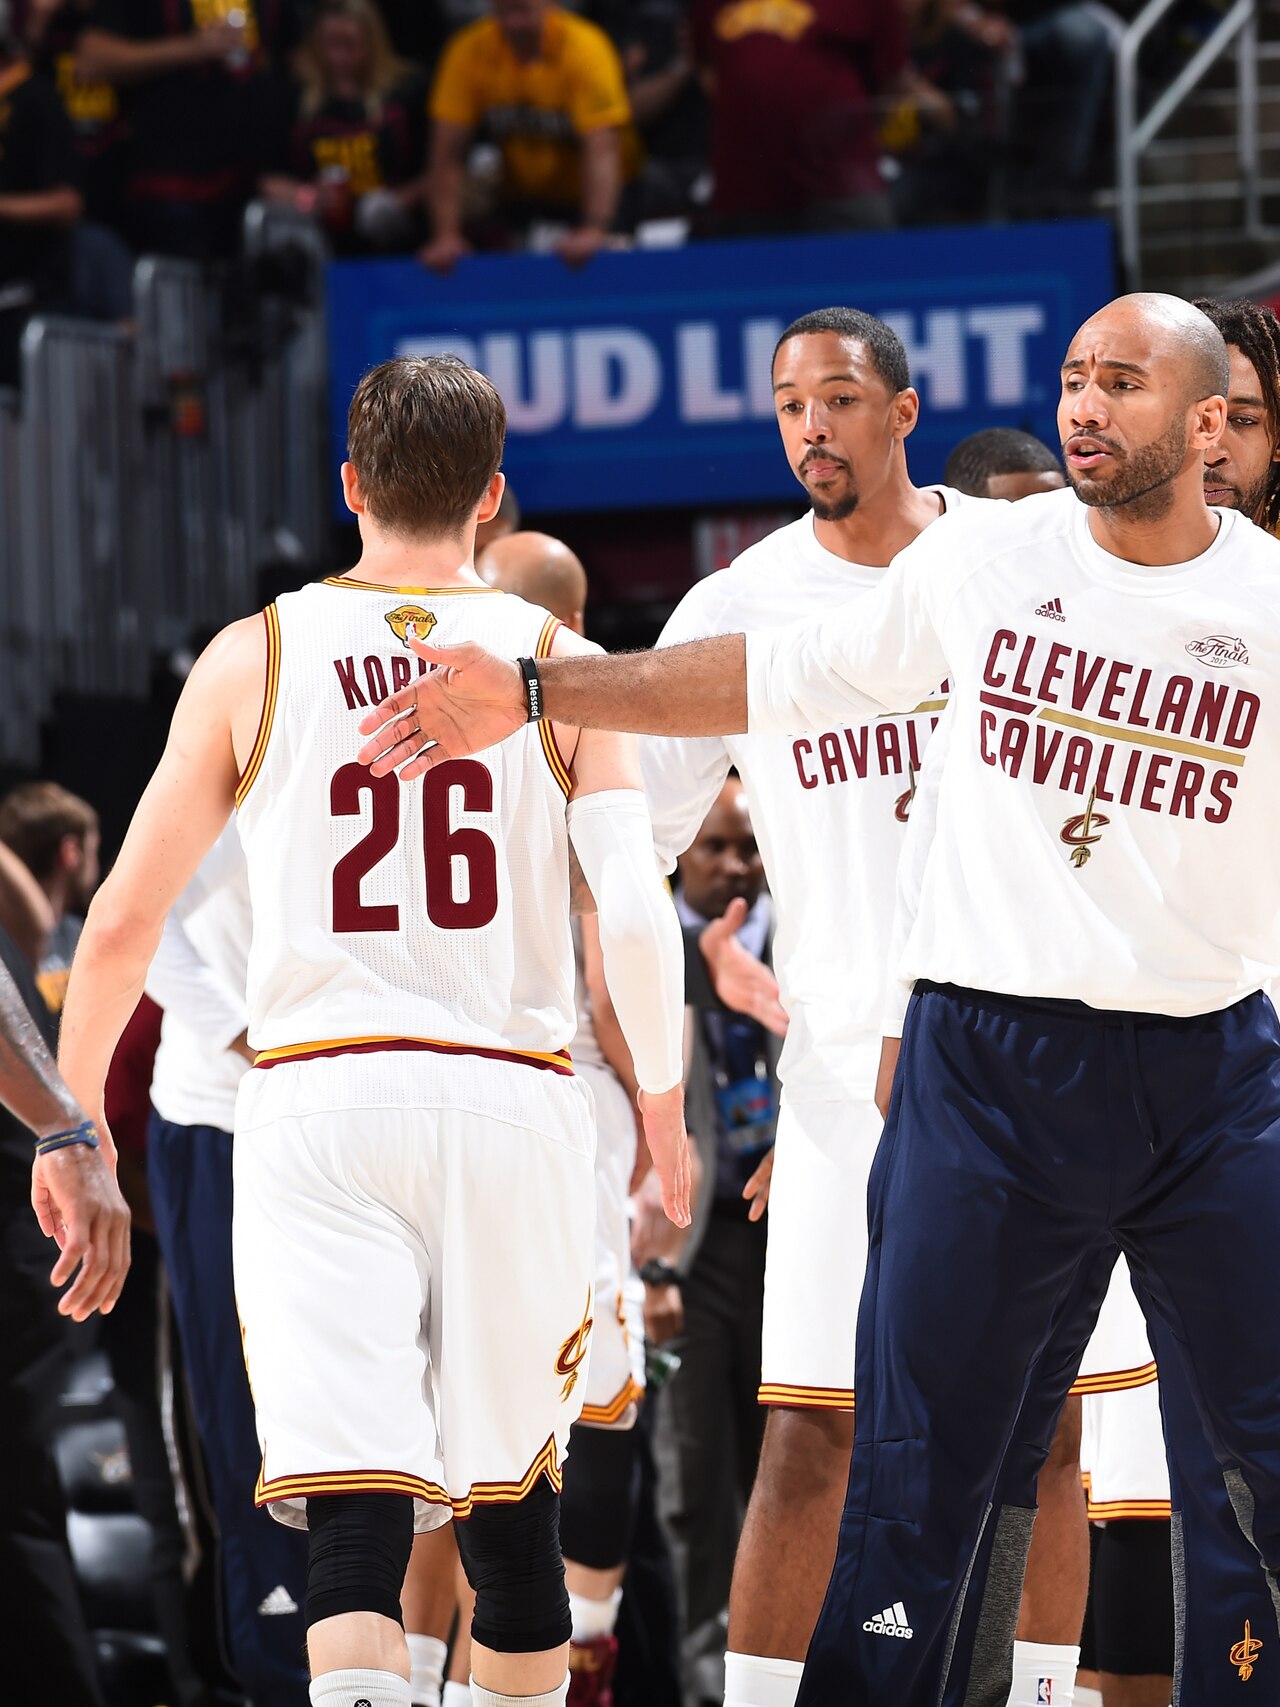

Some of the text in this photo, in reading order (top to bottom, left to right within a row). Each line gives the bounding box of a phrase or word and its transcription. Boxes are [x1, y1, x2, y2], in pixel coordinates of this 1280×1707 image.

[676, 303, 1045, 424] LIHT
[1035, 608, 1067, 623] adidas
[1206, 637, 1251, 666] Finals
[1210, 656, 1229, 666] 2017
[333, 654, 440, 711] KOR
[528, 678, 541, 718] Blessed
[983, 628, 1261, 750] CLEVELAND
[792, 716, 940, 790] CAVAL
[980, 710, 1239, 825] CAVALIERS
[330, 758, 499, 933] 26
[862, 1620, 915, 1640] adidas
